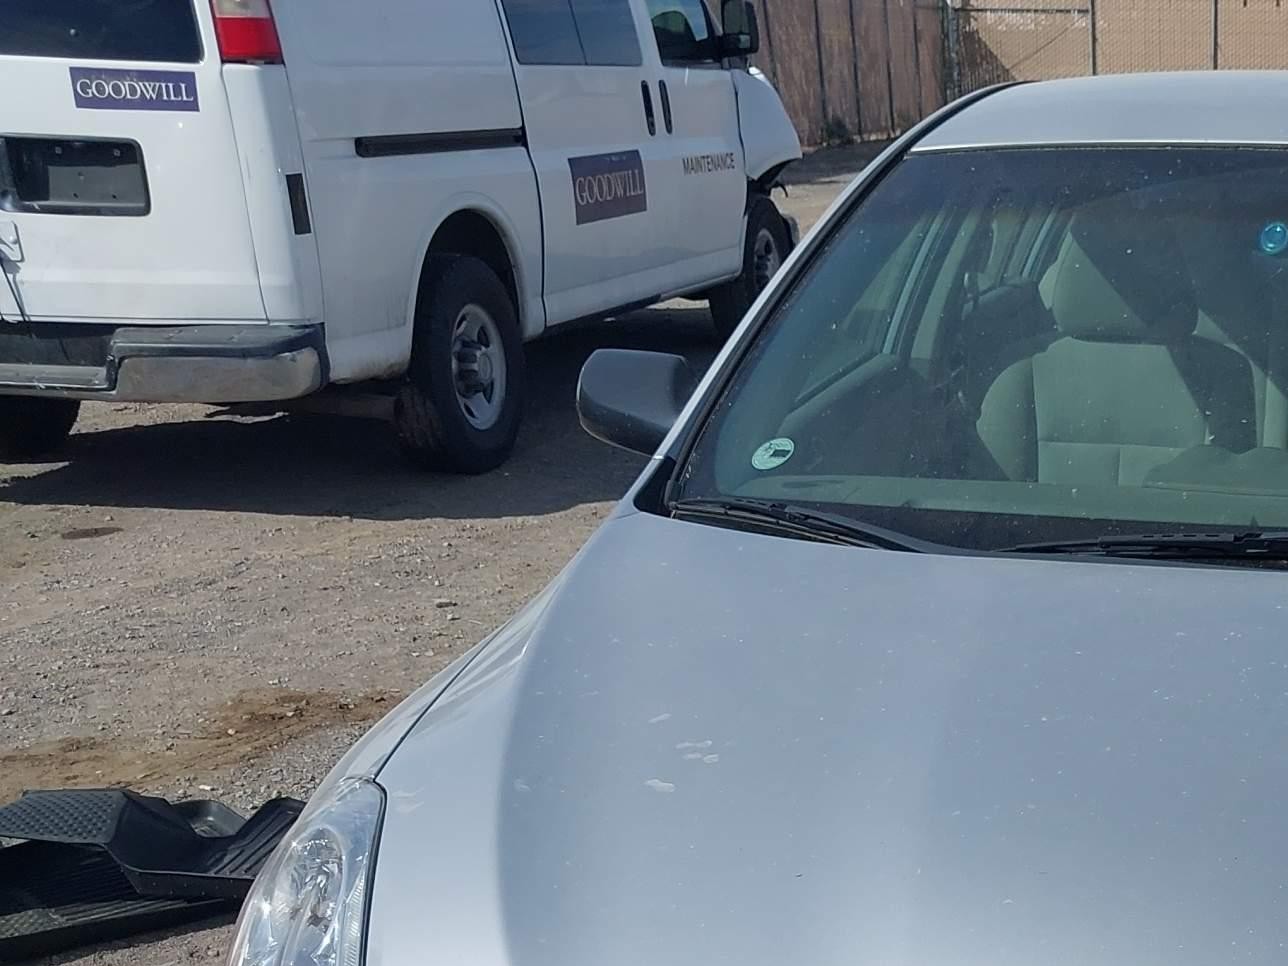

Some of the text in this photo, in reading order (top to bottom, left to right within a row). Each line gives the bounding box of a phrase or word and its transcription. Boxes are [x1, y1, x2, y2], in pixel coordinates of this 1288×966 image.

[76, 79, 194, 101] GOODWILL
[682, 153, 735, 176] MAINTENANCE
[575, 169, 643, 206] GOODWILL
